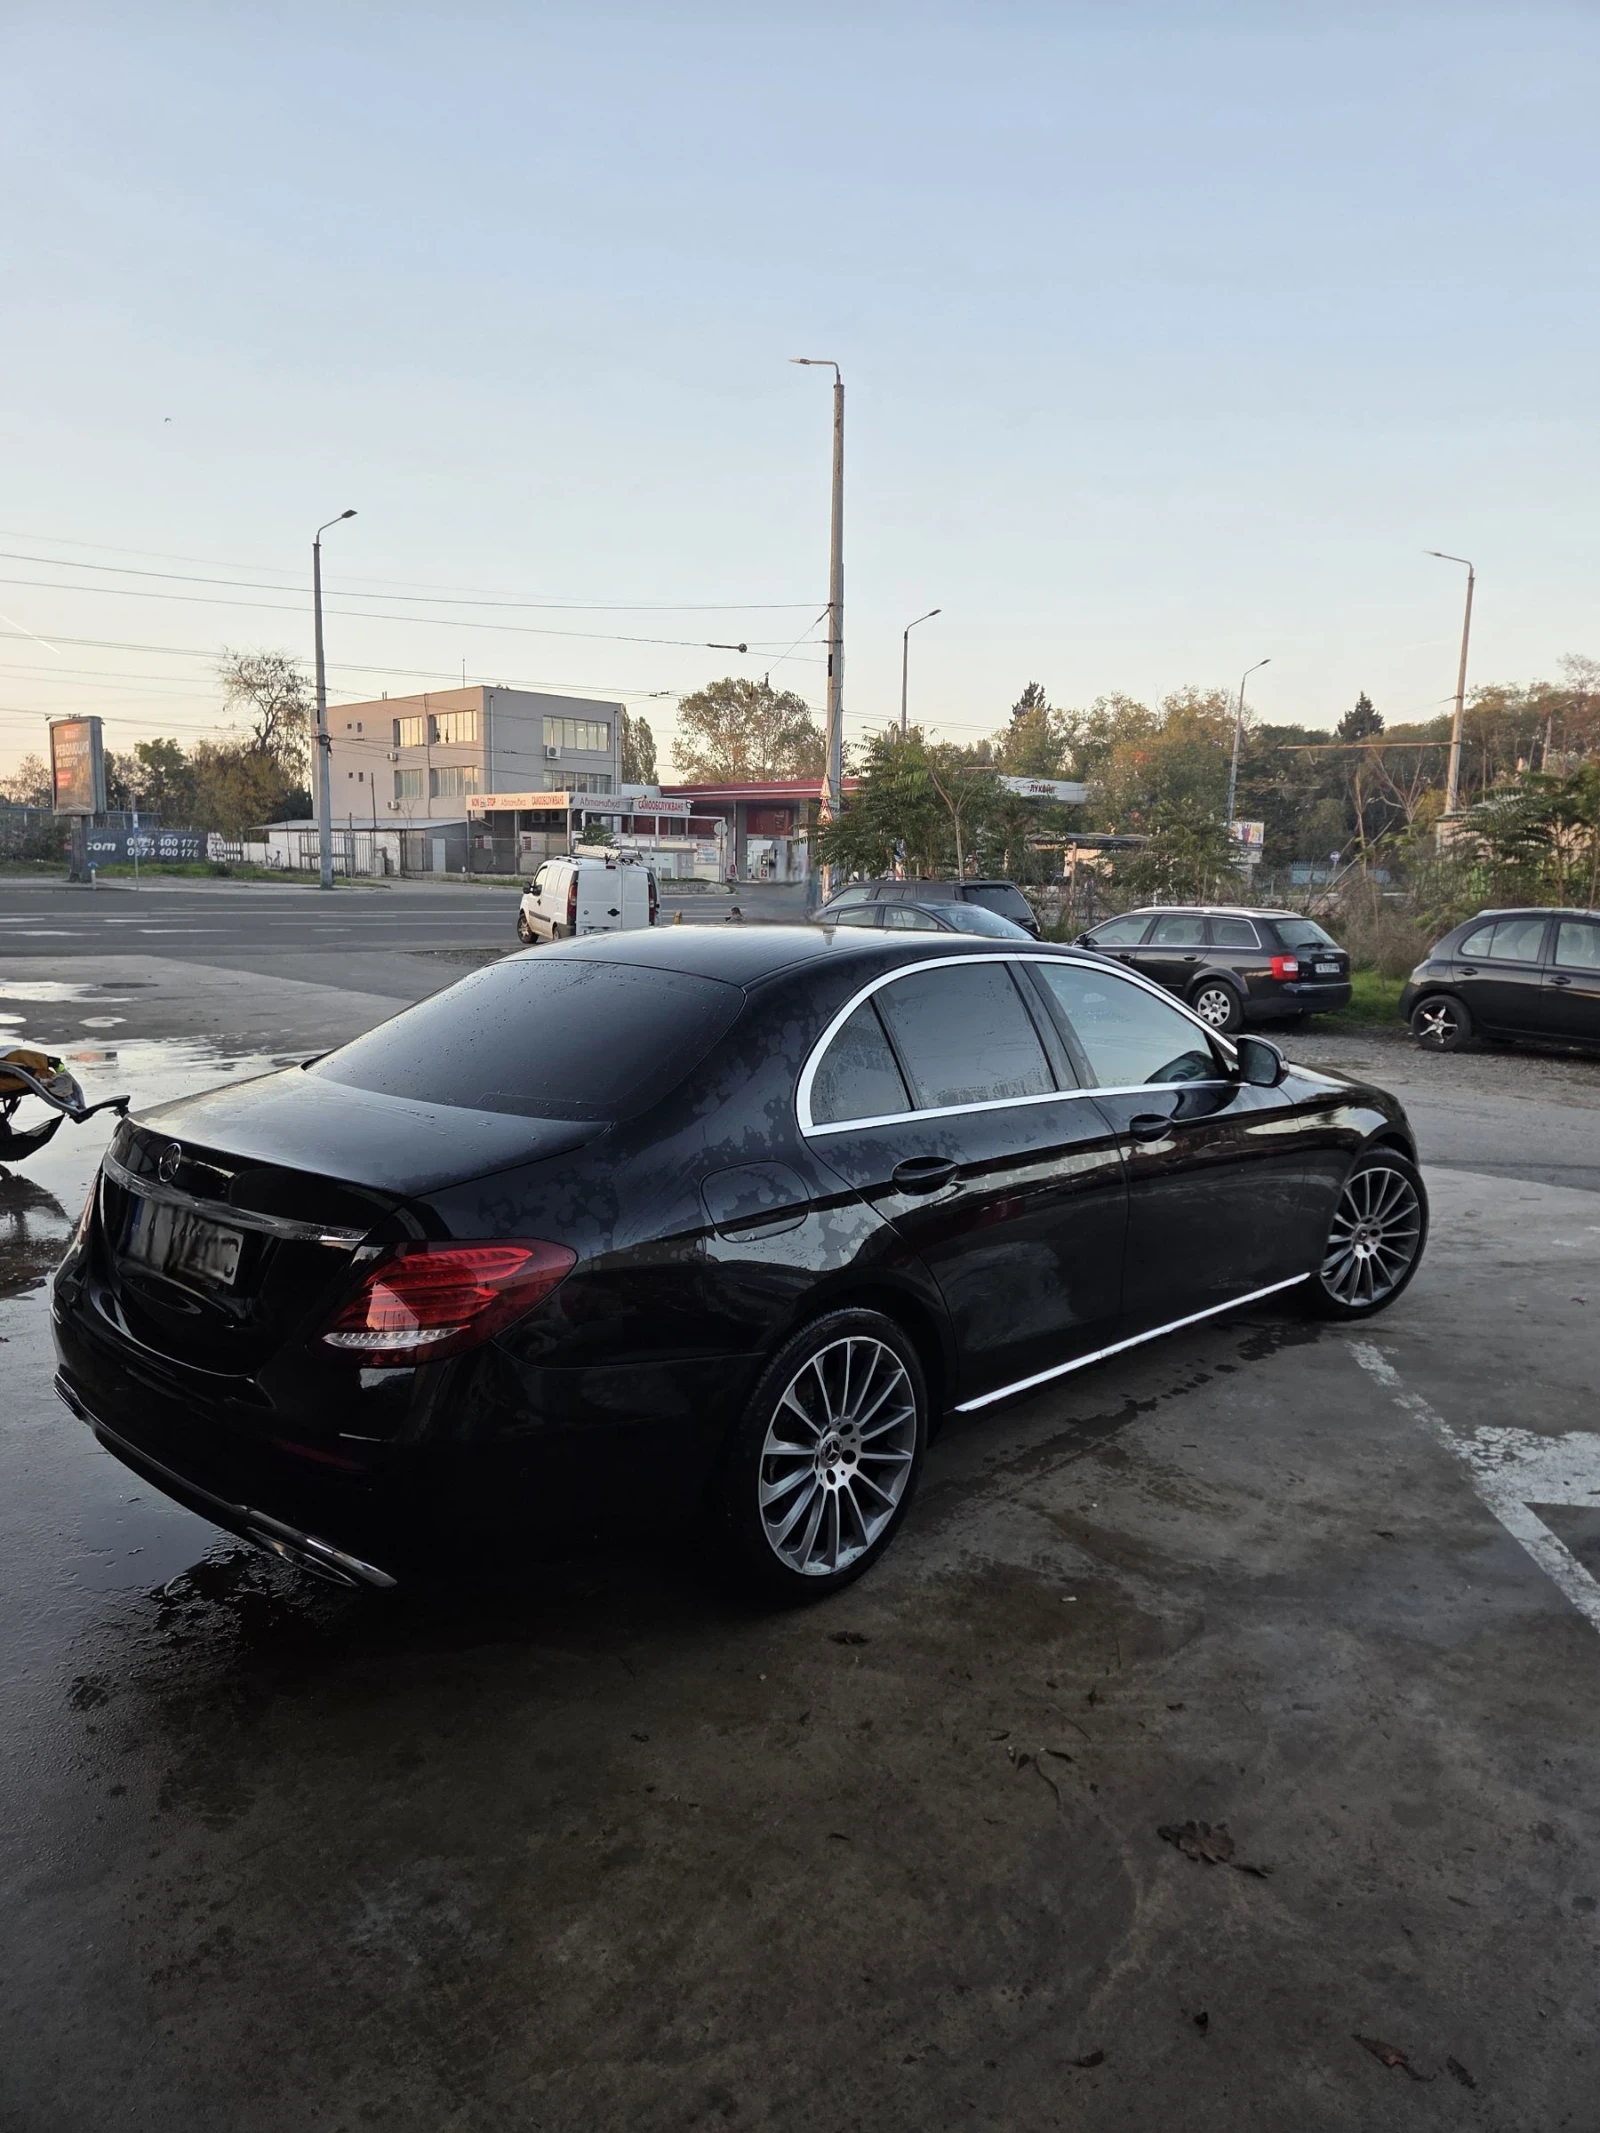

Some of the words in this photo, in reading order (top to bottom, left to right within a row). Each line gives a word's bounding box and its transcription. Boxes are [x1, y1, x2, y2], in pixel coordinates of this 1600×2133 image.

[157, 837, 179, 847] 400
[180, 838, 200, 848] 177
[159, 847, 179, 857] 400
[180, 848, 200, 858] 178
